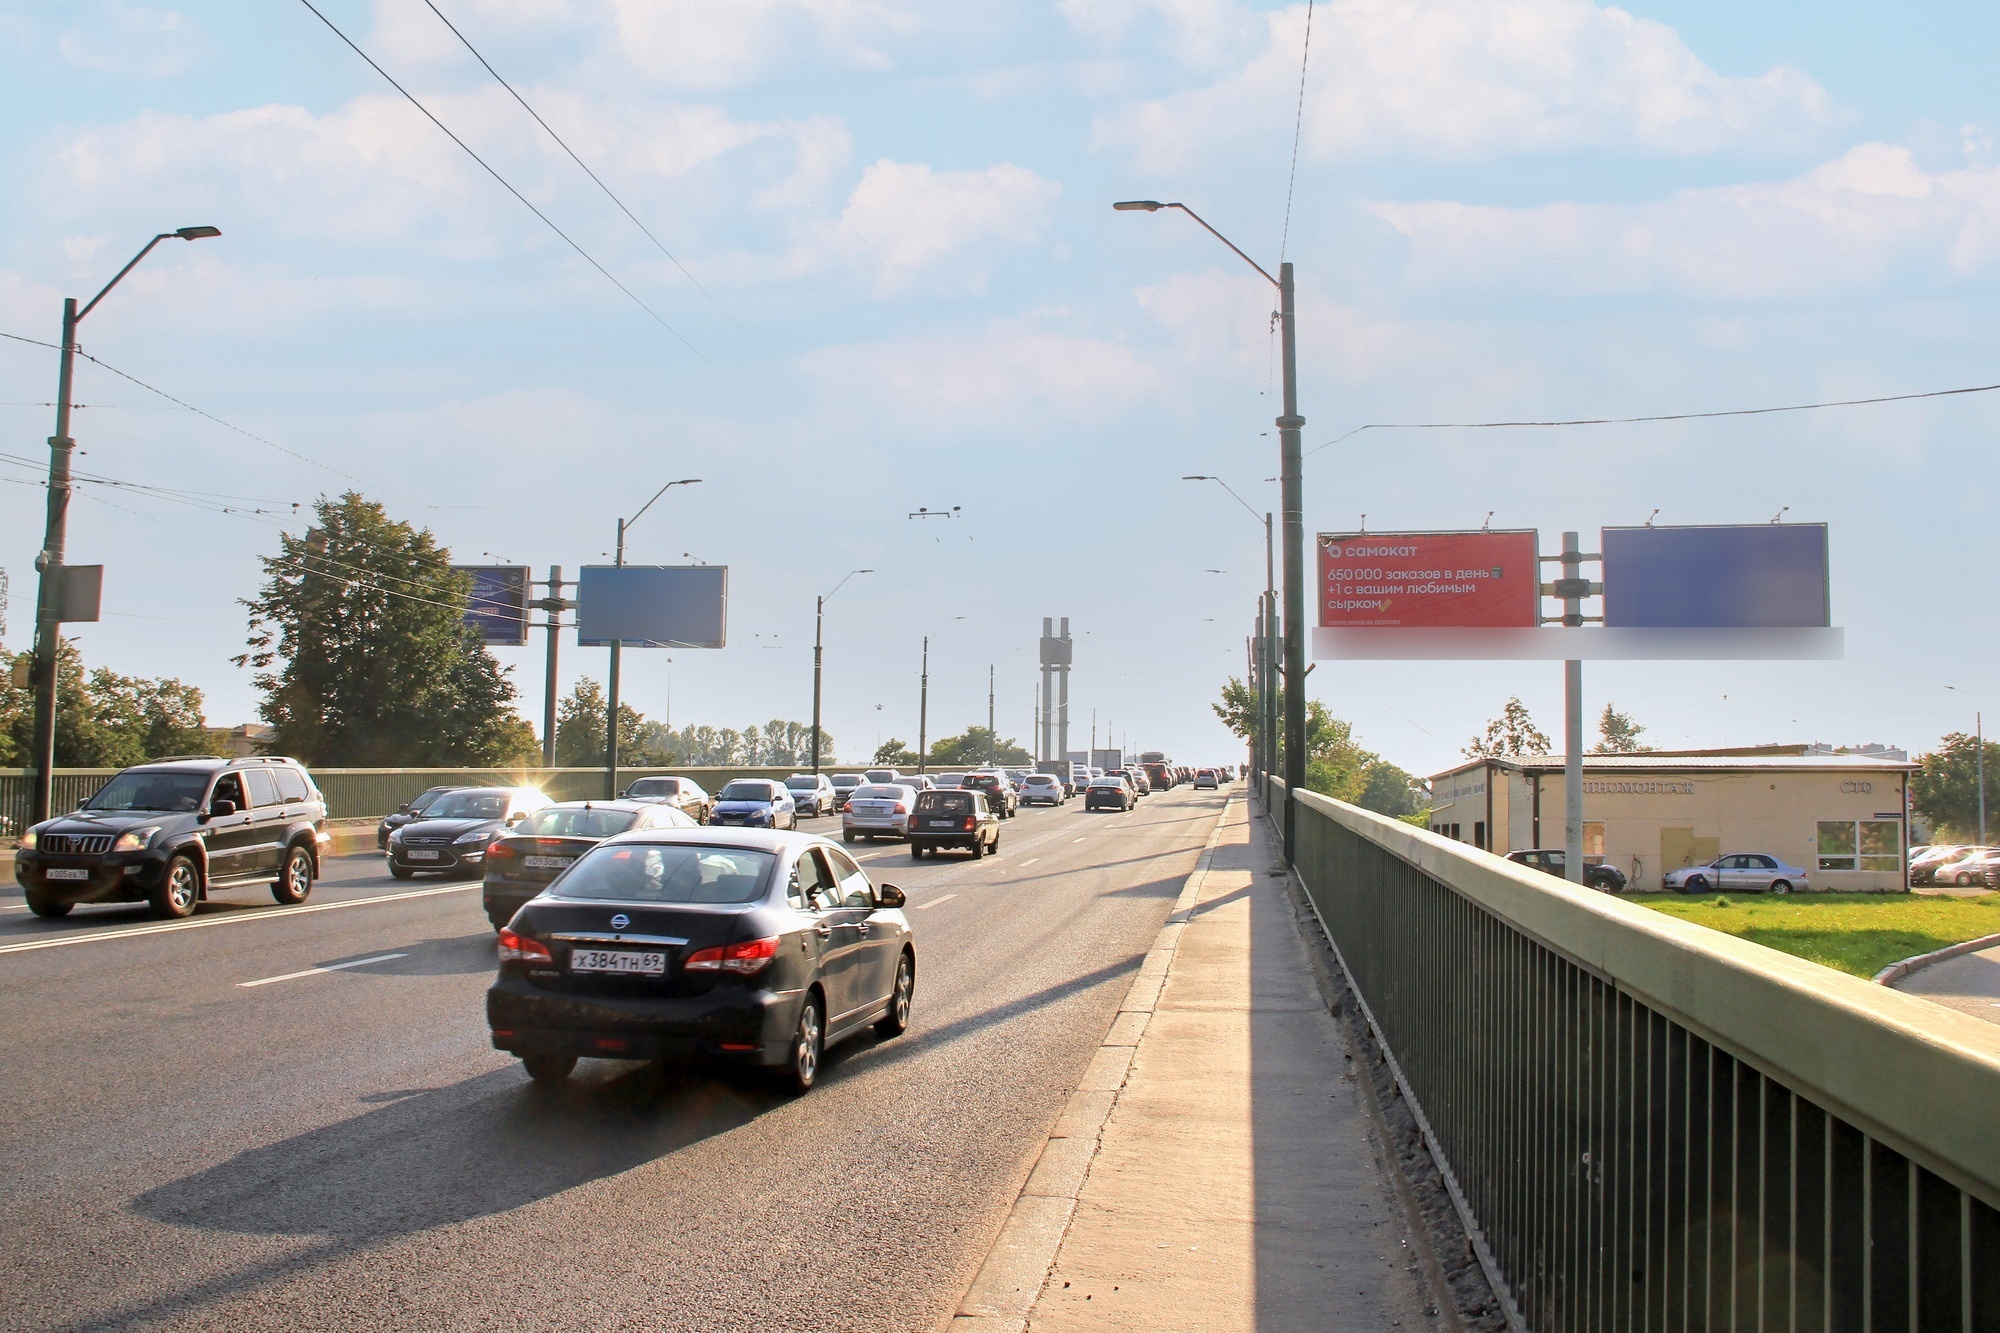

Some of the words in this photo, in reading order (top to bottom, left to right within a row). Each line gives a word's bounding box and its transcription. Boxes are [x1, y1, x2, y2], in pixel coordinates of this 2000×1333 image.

[1345, 545, 1418, 557] самокат
[1385, 570, 1441, 580] заказов
[1444, 570, 1453, 579] в
[1455, 568, 1490, 581] день
[1356, 584, 1403, 595] вашим
[1406, 581, 1476, 594] любимым
[1327, 599, 1382, 611] сырком
[1582, 781, 1695, 794] ИНОМОНТАЖ
[1841, 781, 1874, 793] СТО
[643, 954, 660, 967] 69
